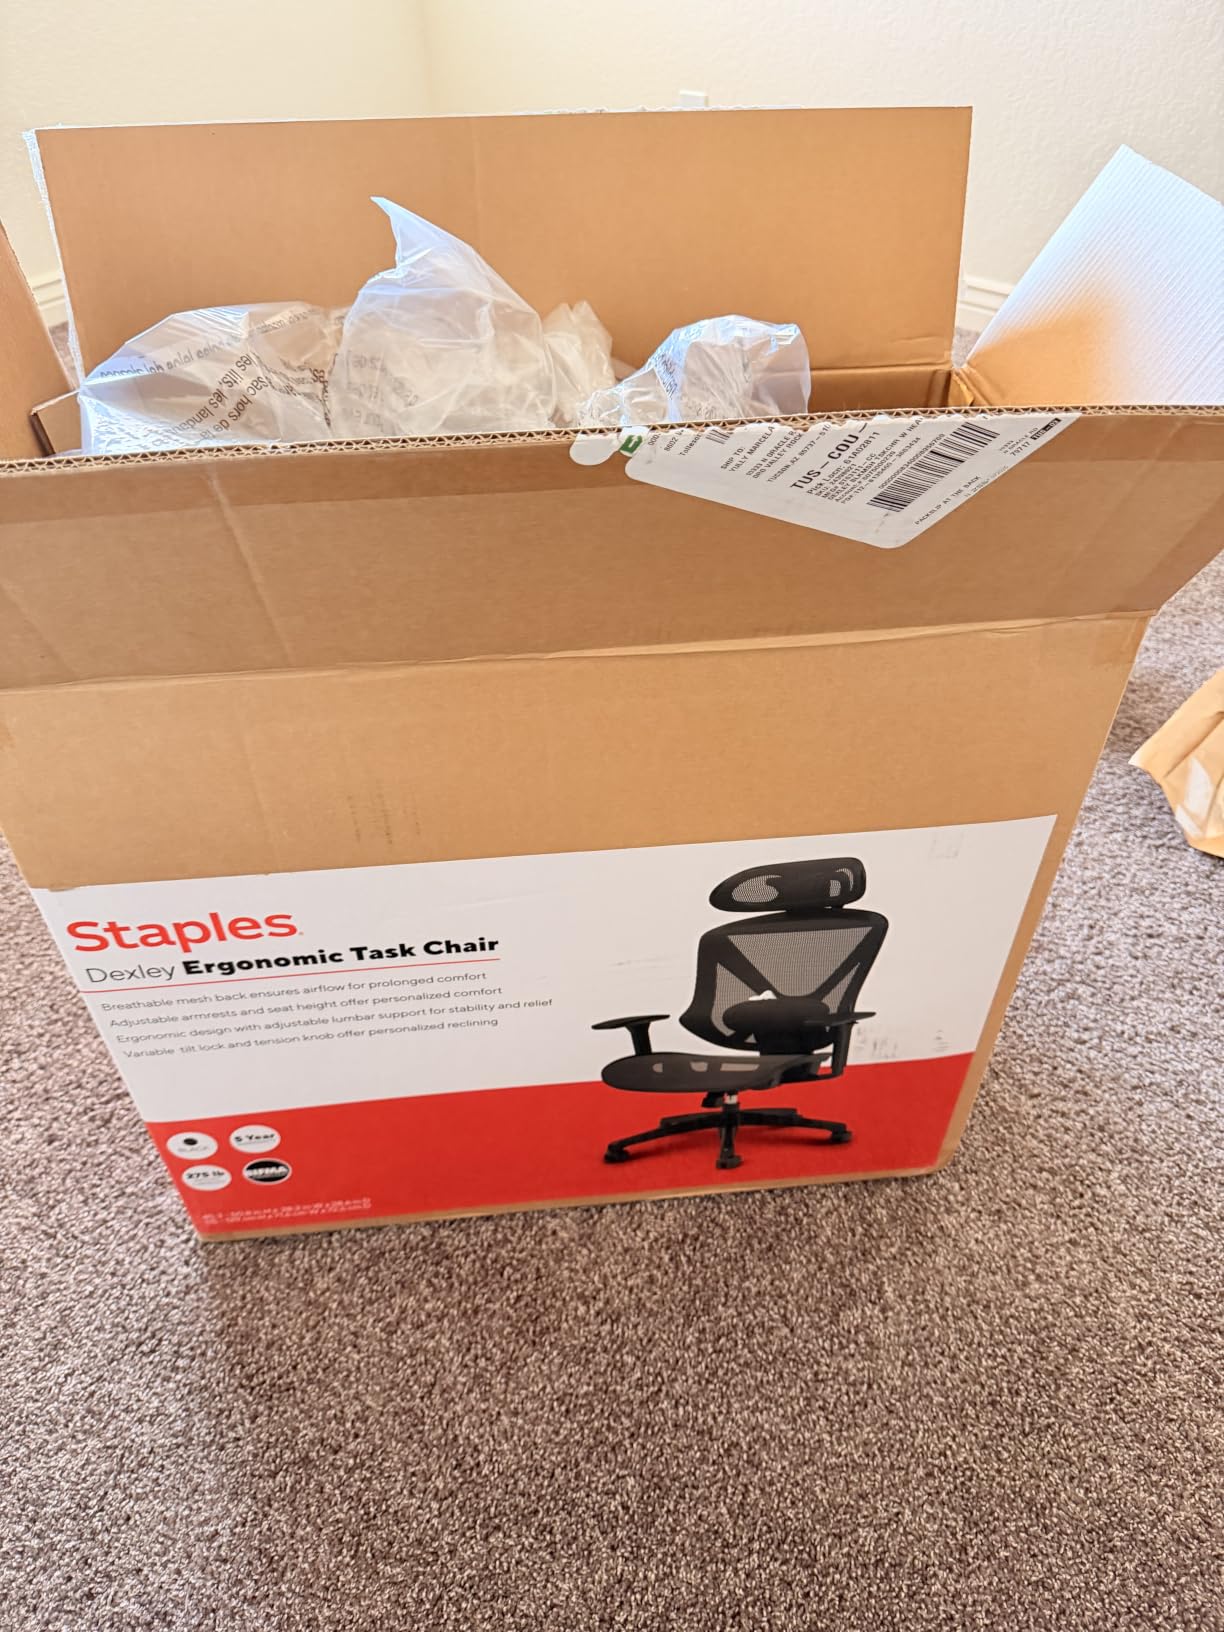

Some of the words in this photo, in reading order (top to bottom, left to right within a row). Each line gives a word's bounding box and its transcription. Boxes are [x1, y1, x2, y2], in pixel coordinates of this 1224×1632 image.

[236, 352, 259, 372] les
[218, 368, 244, 390] lits,
[246, 376, 268, 396] sac
[208, 387, 228, 410] les
[228, 395, 253, 421] hors
[212, 419, 230, 436] de
[621, 434, 643, 454] E
[747, 426, 776, 456] MARCELA
[766, 439, 788, 459] ORACLE
[766, 447, 788, 469] VALLEY
[787, 433, 803, 450] ROCK
[720, 457, 734, 470] SHIP
[806, 481, 824, 495] Pick
[950, 487, 964, 499] THE
[963, 475, 981, 489] BACK
[66, 912, 298, 953] Staples
[85, 965, 176, 983] Dexley
[182, 949, 344, 976] Ergonomic
[349, 943, 416, 961] Task
[423, 937, 499, 955] Chair
[101, 999, 174, 1011] Breathable
[176, 994, 213, 1005] mesh
[214, 992, 247, 1001] back
[249, 988, 301, 998] ensures
[303, 984, 345, 994] airflow
[347, 981, 367, 990] for
[368, 976, 434, 989] prolonged
[436, 972, 487, 983] comfort
[109, 1015, 180, 1028] Adjustable
[181, 1009, 238, 1021] armrests
[240, 1006, 265, 1016] and
[267, 1004, 294, 1013] seat
[296, 1000, 338, 1011] height
[340, 997, 370, 1006] offer
[372, 991, 451, 1005] personalized
[453, 986, 503, 998] comfort
[116, 1031, 188, 1044] Ergonomic
[189, 1025, 233, 1036] design
[233, 1023, 262, 1033] with
[264, 1018, 330, 1031] adjustable
[332, 1013, 376, 1024] lumbar
[378, 1009, 427, 1020] support
[429, 1006, 446, 1015] for
[449, 1002, 496, 1014] stability
[497, 1001, 522, 1010] and
[524, 998, 554, 1008] relief
[123, 1048, 177, 1058] Variable
[179, 1045, 197, 1054] tilt
[199, 1043, 226, 1052] lock
[228, 1040, 252, 1049] and
[254, 1036, 301, 1047] tension
[302, 1033, 336, 1042] knob
[337, 1030, 367, 1040] offer
[368, 1022, 445, 1037] personalized
[447, 1018, 500, 1030] reclining
